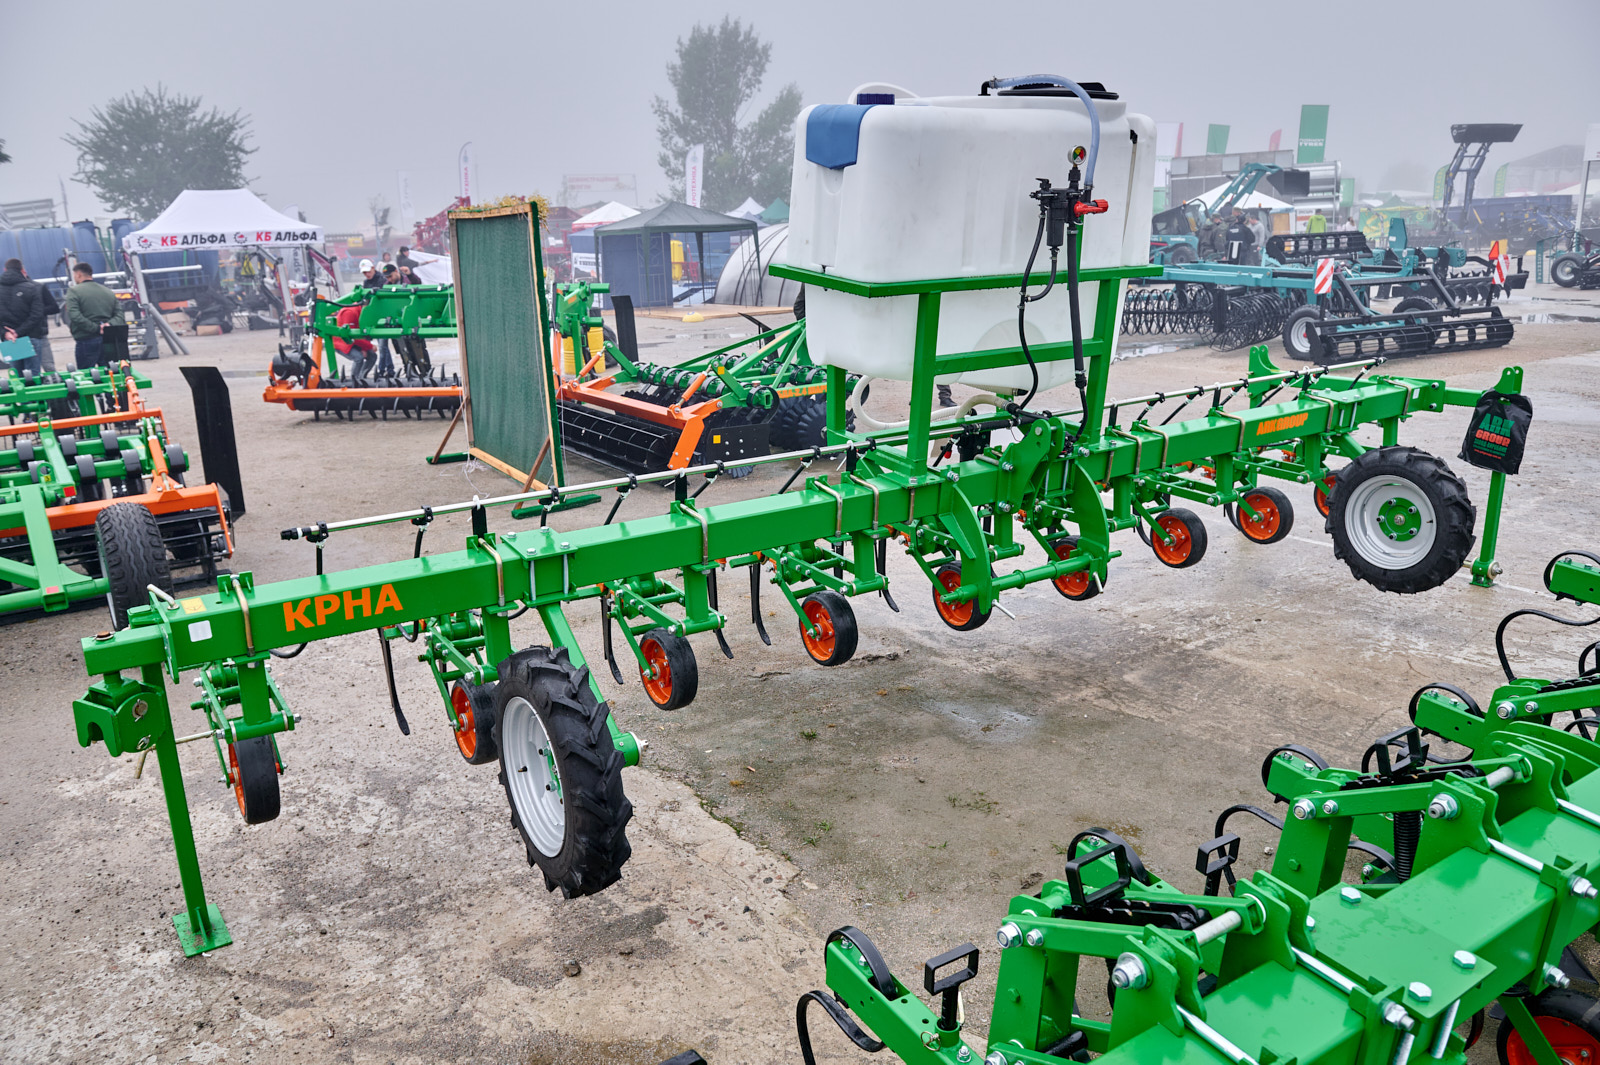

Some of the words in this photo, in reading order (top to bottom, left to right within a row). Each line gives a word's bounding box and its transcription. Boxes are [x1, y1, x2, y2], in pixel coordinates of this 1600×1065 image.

[161, 235, 178, 246] КБ
[181, 233, 226, 245] АЛЬФА
[256, 231, 272, 242] КБ
[275, 231, 317, 241] АЛЬФА
[1479, 412, 1515, 437] ARK
[1475, 429, 1511, 447] GROUP
[282, 583, 404, 632] КРНА
